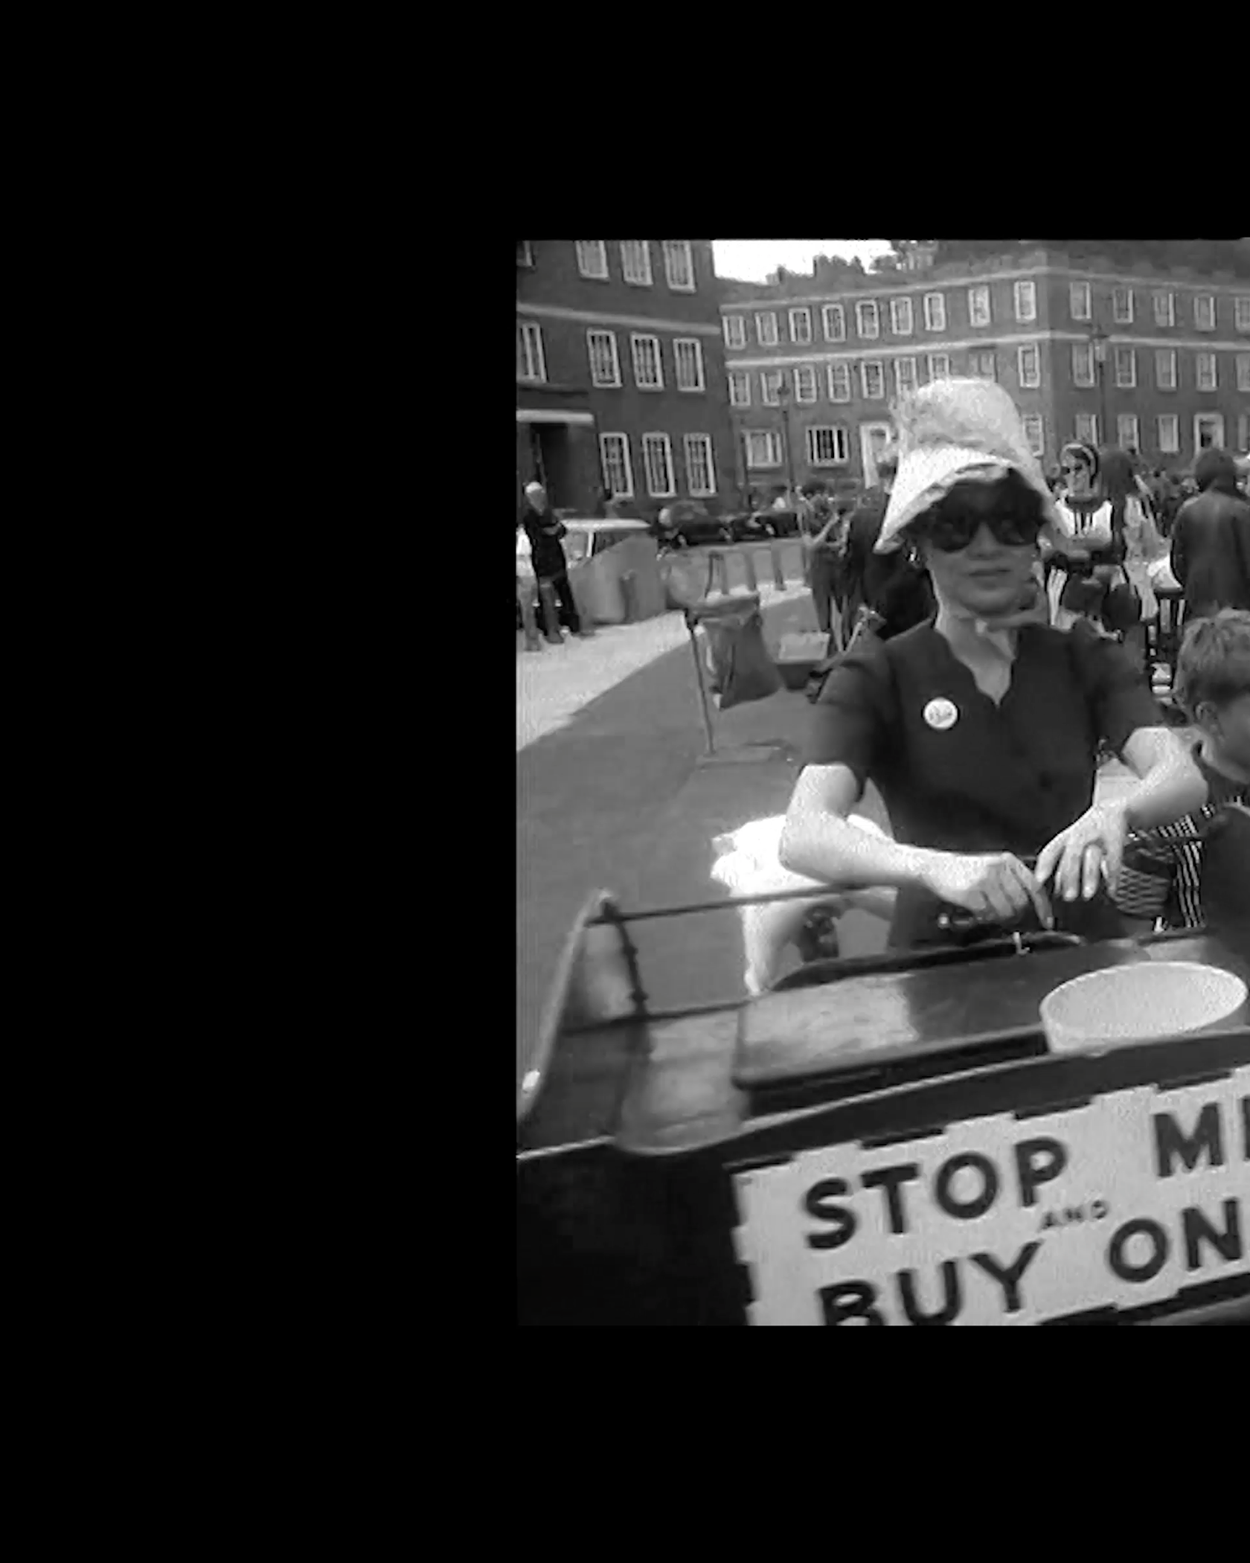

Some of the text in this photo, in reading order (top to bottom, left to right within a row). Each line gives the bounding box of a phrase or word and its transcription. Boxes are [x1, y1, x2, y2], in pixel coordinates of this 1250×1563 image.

[803, 1138, 1067, 1250] STOP
[1040, 1200, 1109, 1231] AND
[819, 1240, 1042, 1326] BUY
